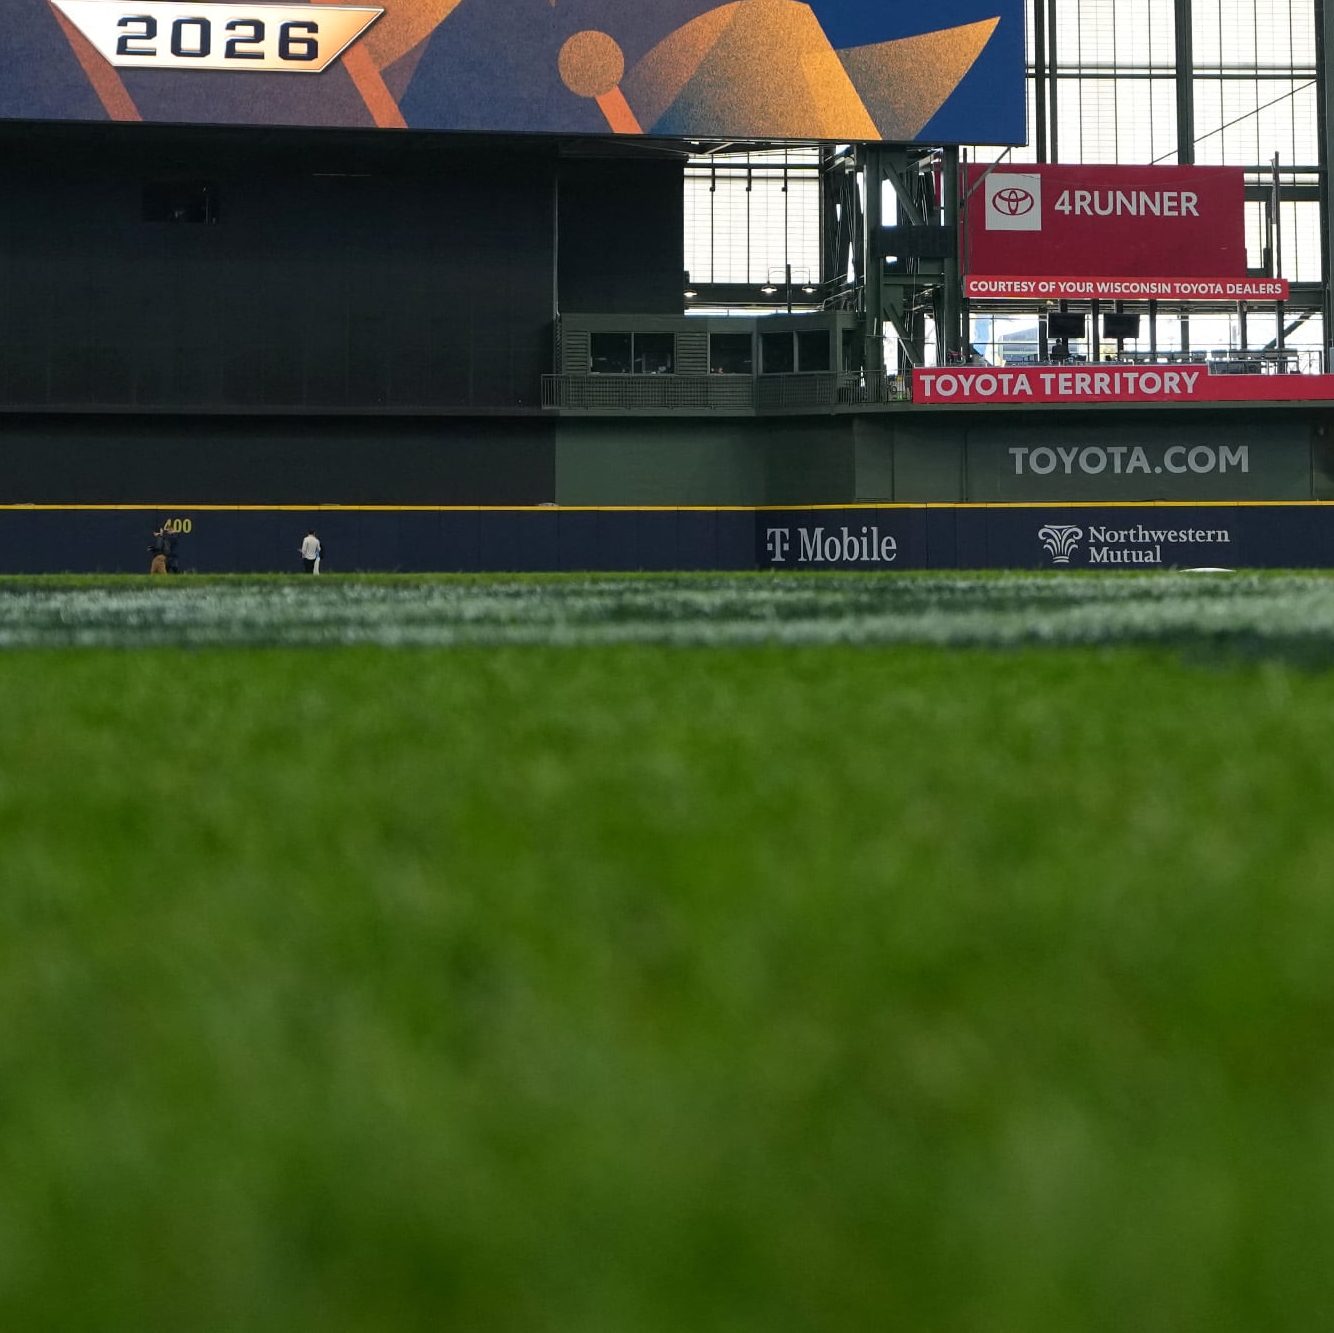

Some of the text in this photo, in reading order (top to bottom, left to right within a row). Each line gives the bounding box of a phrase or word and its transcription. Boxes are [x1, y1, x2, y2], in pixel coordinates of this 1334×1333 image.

[115, 13, 320, 63] 2026
[1054, 189, 1200, 217] 4RUNNER
[969, 280, 1283, 294] COURTESY OF YOUR WISCONSIN TOYOTA DEALERS
[920, 371, 1200, 397] TOYOTA TERRITORY
[1008, 445, 1250, 475] TOYOTA.COM
[163, 518, 193, 534] 400
[1088, 525, 1231, 544] Northwestern
[797, 527, 898, 562] Mobile
[1089, 546, 1162, 564] Mutual
